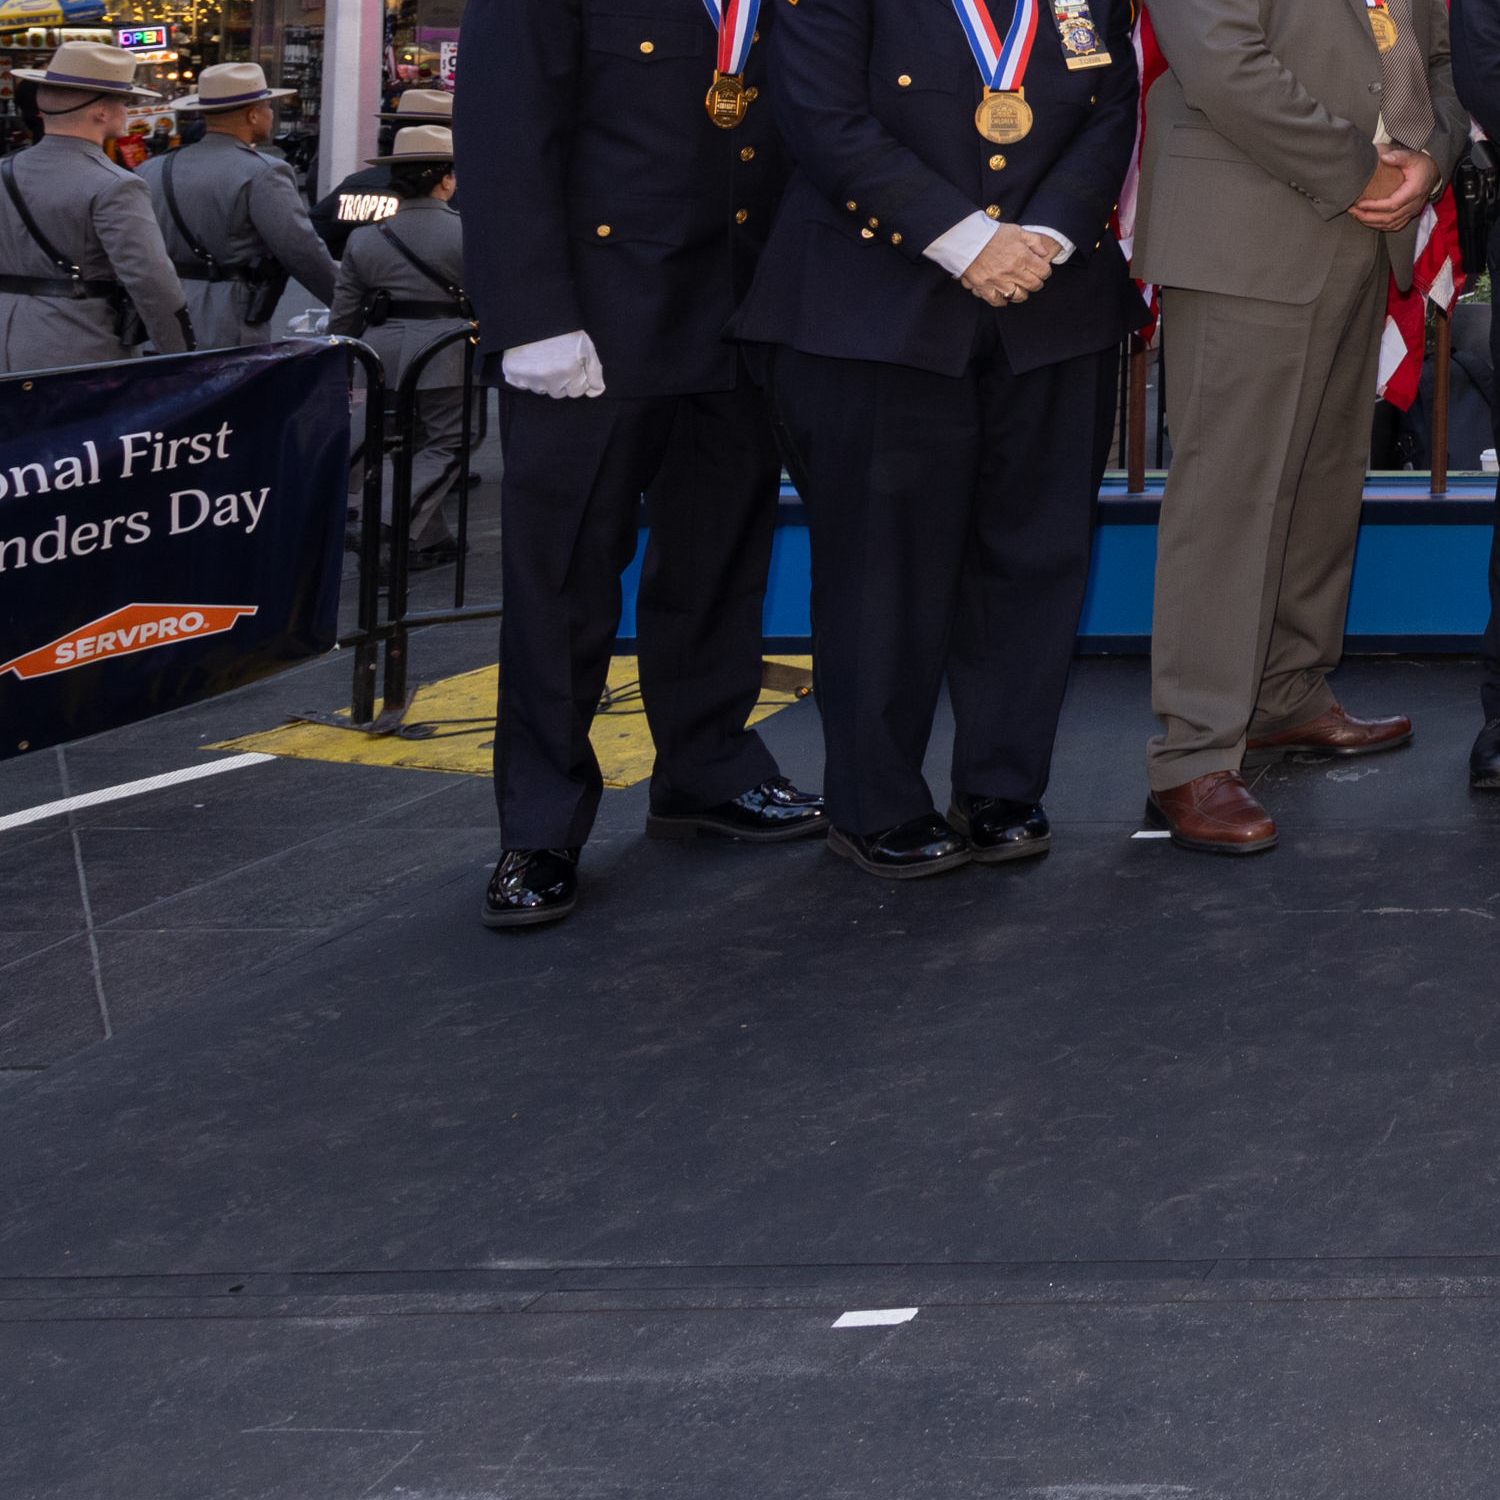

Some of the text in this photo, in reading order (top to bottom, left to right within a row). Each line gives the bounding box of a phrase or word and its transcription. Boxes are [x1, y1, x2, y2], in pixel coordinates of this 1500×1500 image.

[122, 30, 163, 45] OPEN
[1078, 57, 1101, 65] TOBIN
[339, 194, 398, 223] TROOPER
[118, 420, 233, 479] First
[168, 486, 271, 537] Day
